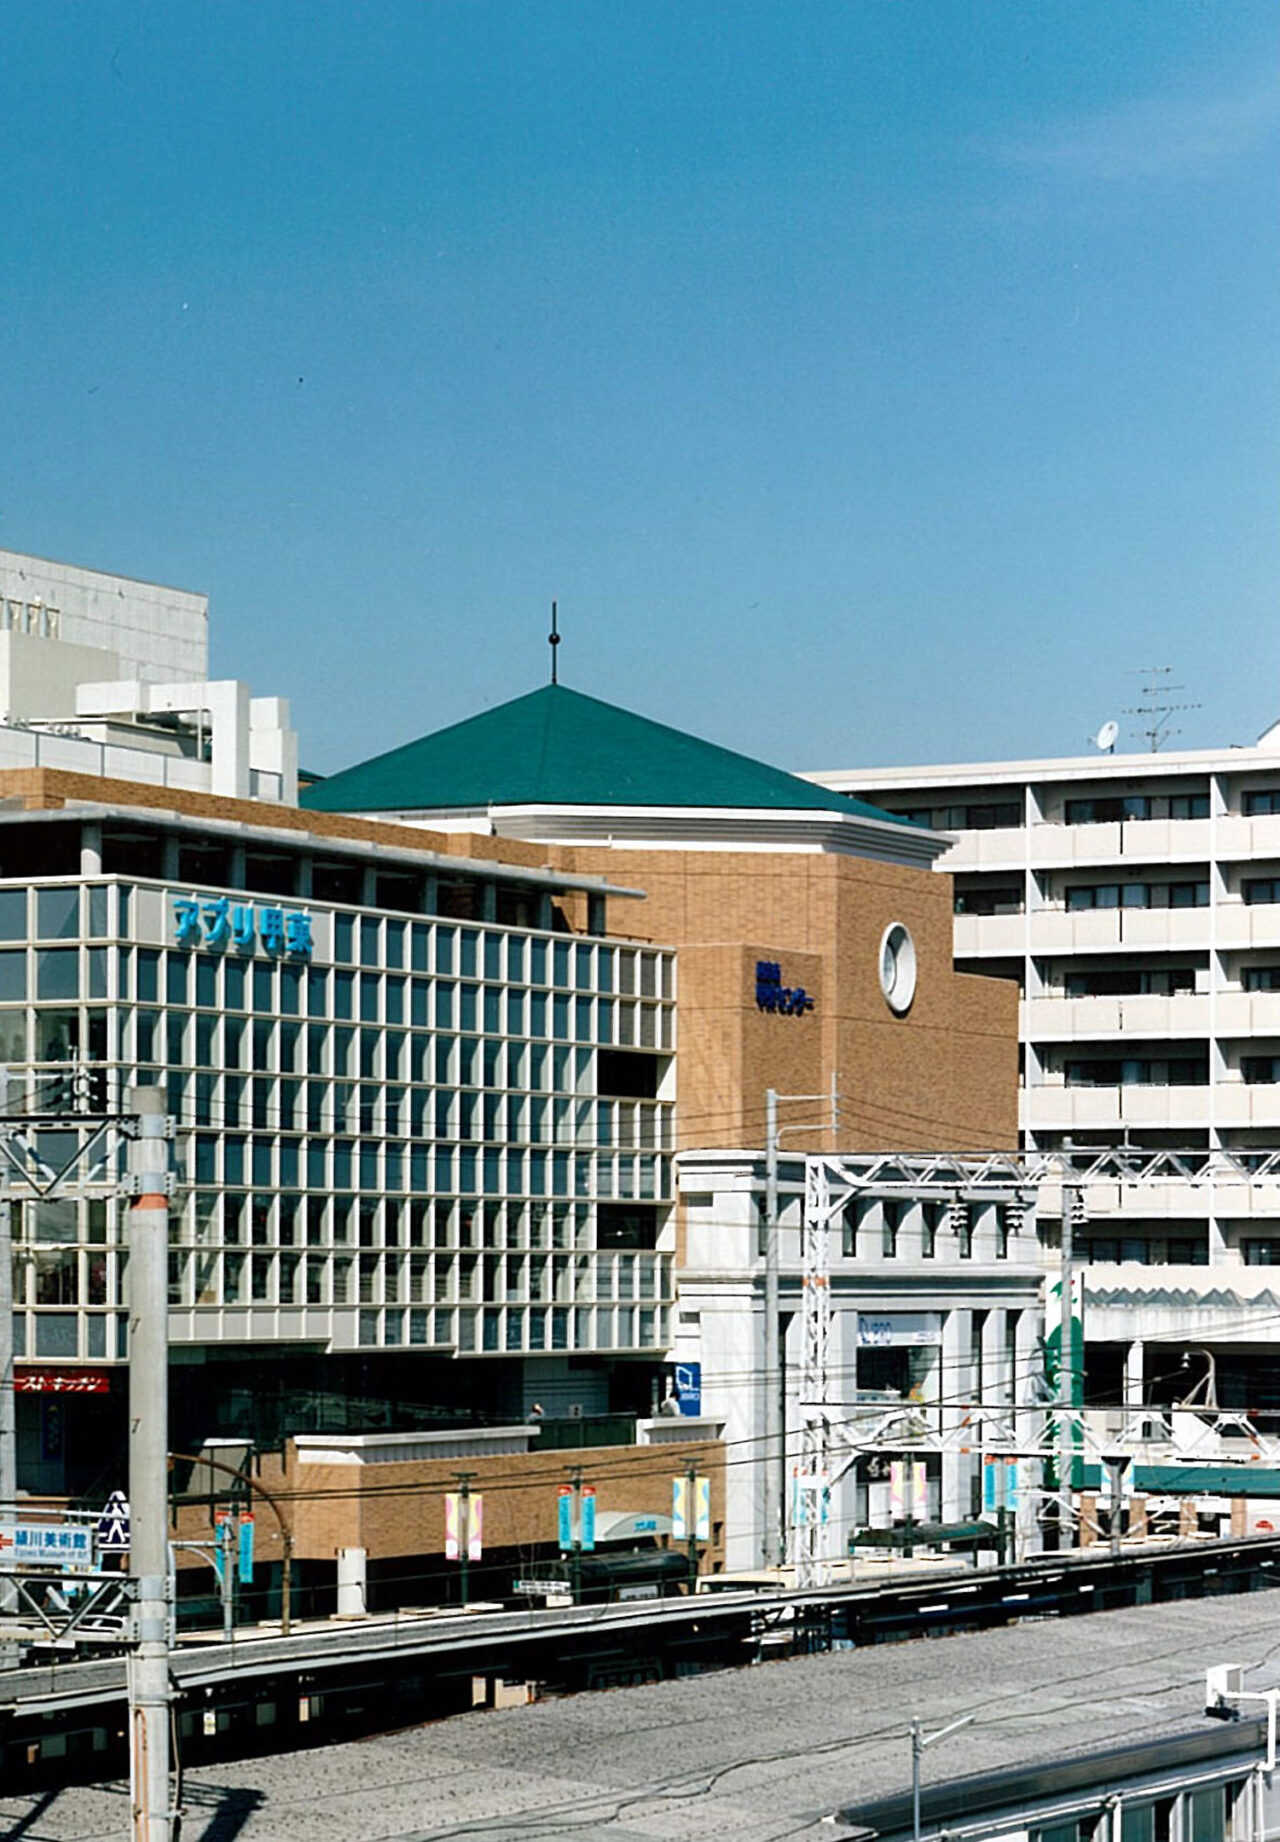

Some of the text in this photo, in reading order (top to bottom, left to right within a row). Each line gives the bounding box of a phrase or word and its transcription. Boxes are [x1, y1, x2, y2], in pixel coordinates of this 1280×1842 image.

[173, 896, 313, 955] アプリ甲東
